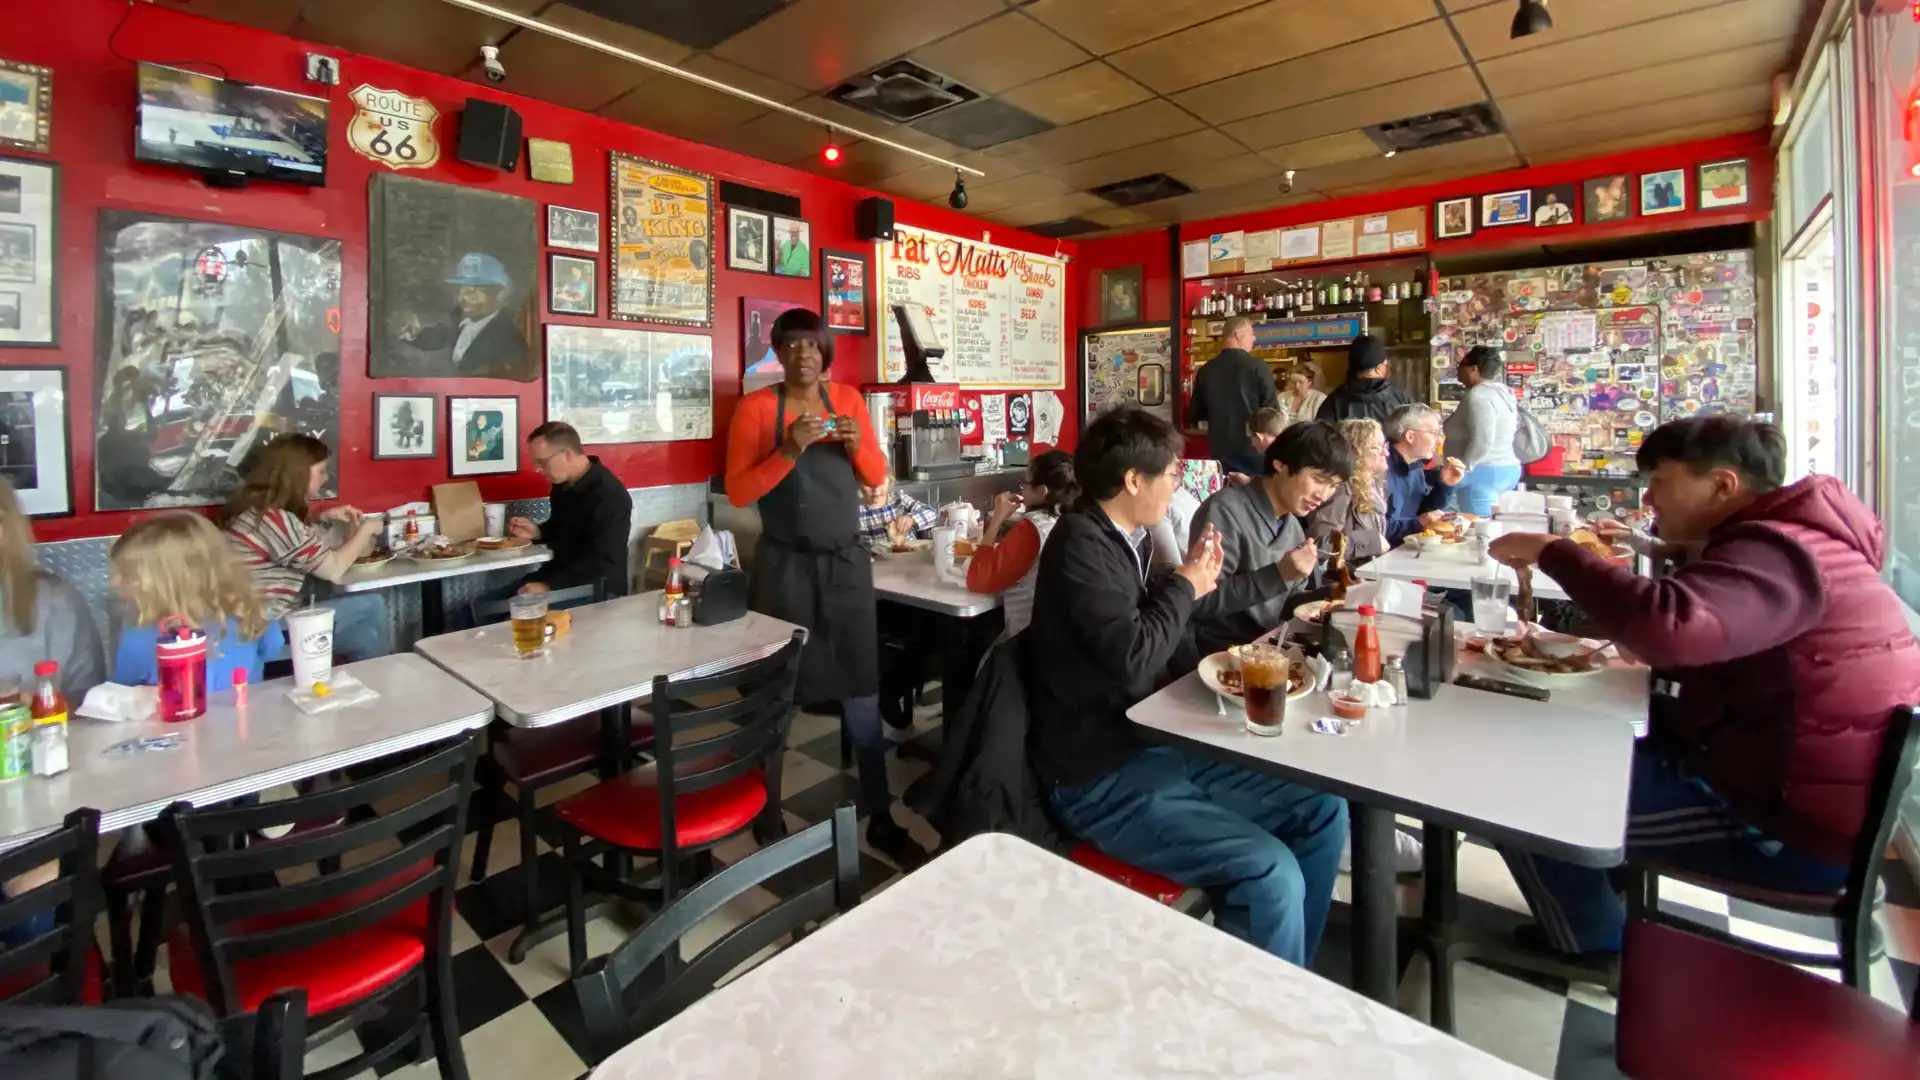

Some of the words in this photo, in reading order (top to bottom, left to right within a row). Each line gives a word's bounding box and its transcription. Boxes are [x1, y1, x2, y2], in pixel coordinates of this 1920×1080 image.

[366, 93, 421, 117] ROUTE
[370, 130, 417, 161] 66
[642, 219, 705, 237] KING
[890, 229, 930, 265] Fat
[935, 239, 1009, 279] Matts
[1006, 251, 1029, 275] Rib
[897, 265, 921, 280] RIBS
[1020, 265, 1056, 287] Shack
[963, 279, 989, 291] CHICKEN
[967, 299, 987, 310] SIDES
[1020, 308, 1037, 320] BEER
[922, 389, 955, 408] Coca-Cola
